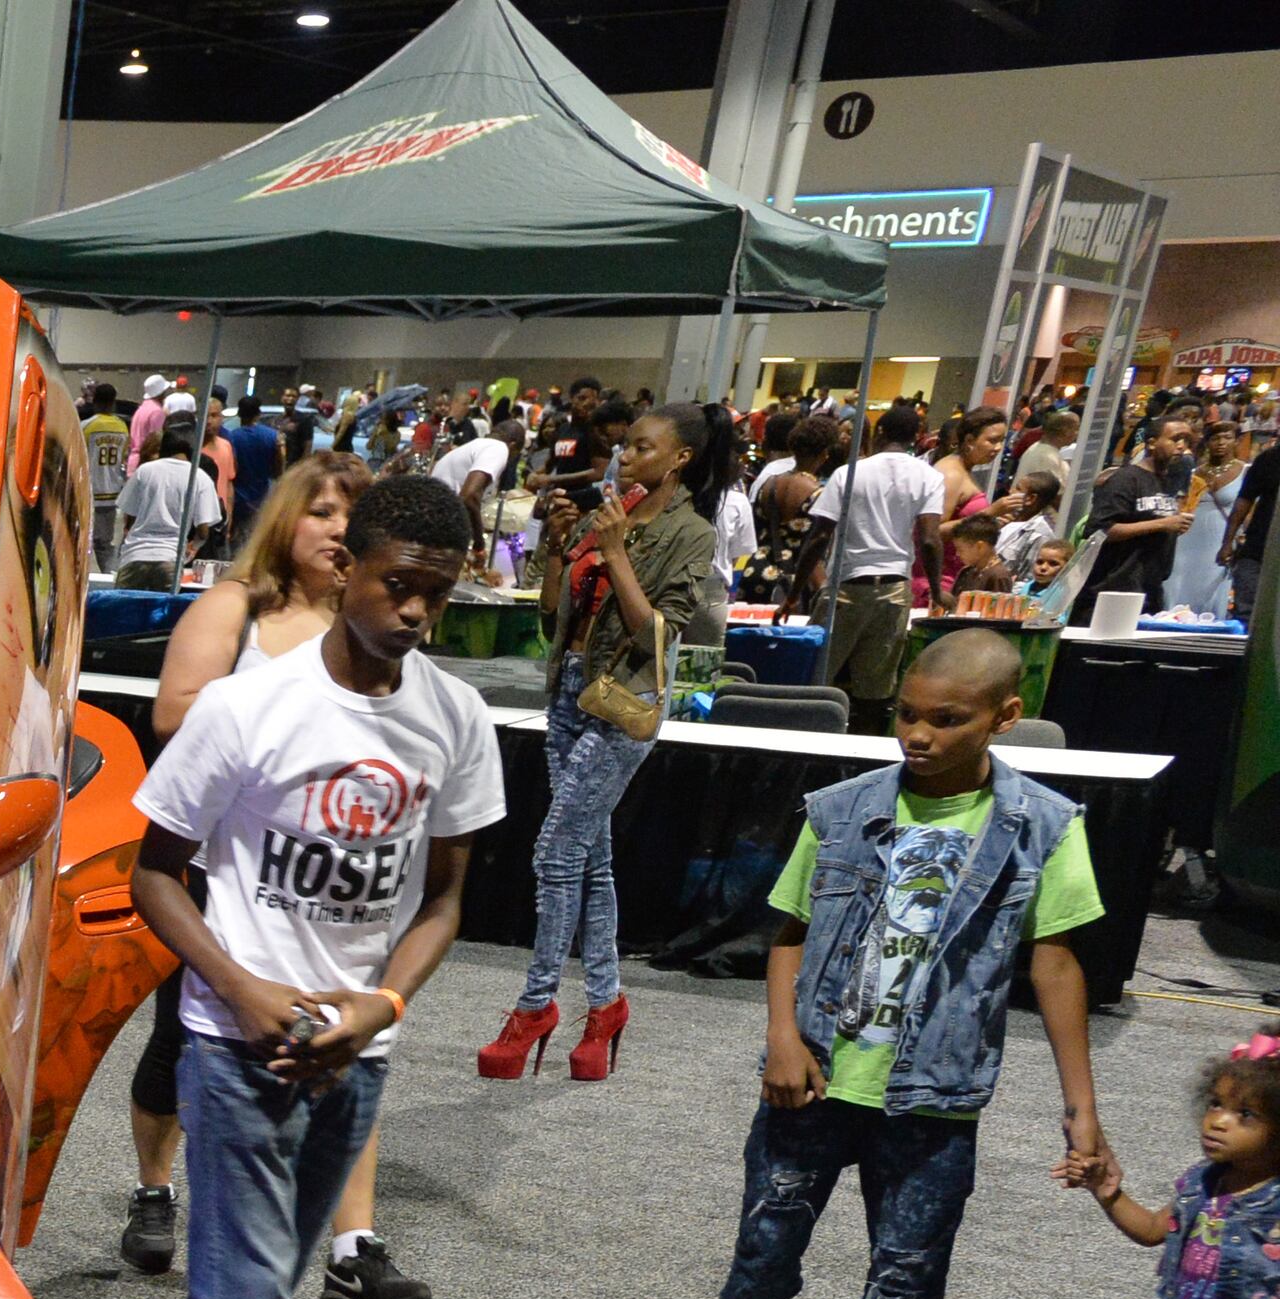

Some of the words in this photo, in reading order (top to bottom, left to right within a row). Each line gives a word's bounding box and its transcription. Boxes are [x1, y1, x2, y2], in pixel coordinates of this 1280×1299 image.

[791, 205, 982, 238] shments
[1176, 347, 1223, 365] PAPA
[1225, 346, 1280, 364] JOHN
[99, 446, 118, 466] 88
